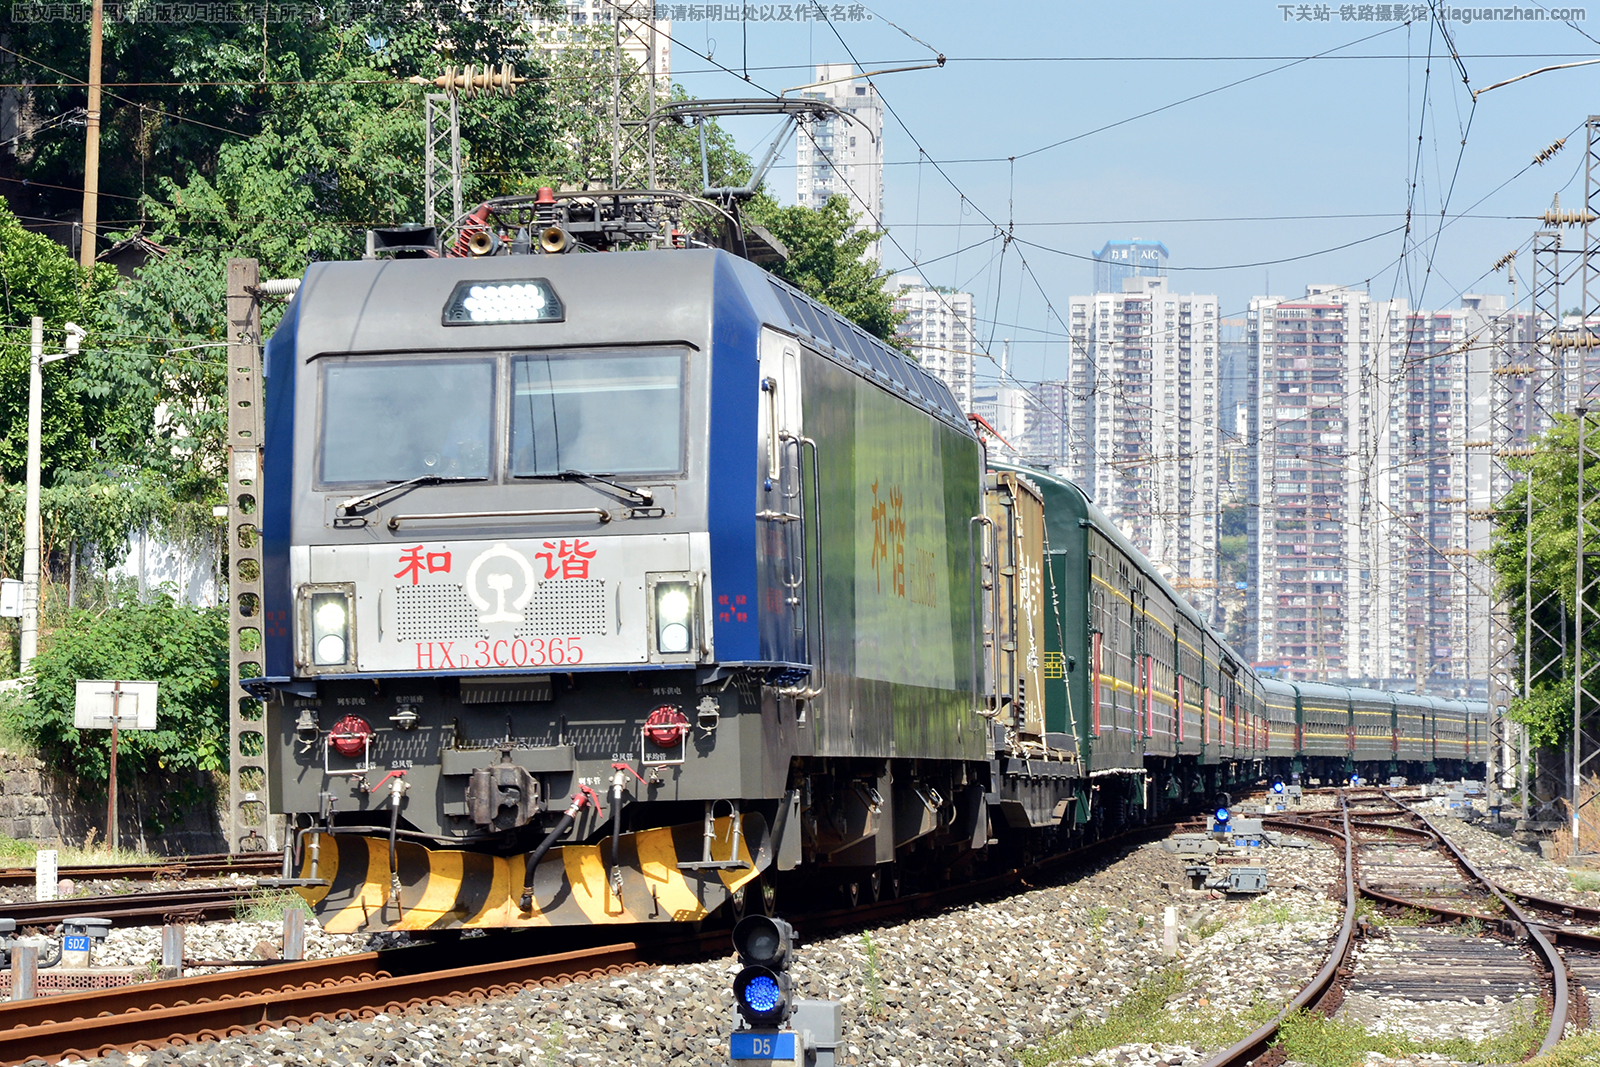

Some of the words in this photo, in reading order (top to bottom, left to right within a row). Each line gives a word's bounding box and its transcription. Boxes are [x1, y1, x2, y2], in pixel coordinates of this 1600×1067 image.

[1140, 250, 1158, 260] AIC
[416, 636, 584, 669] HXD3C0365
[68, 938, 85, 950] 5DZ
[753, 1038, 771, 1055] D5
